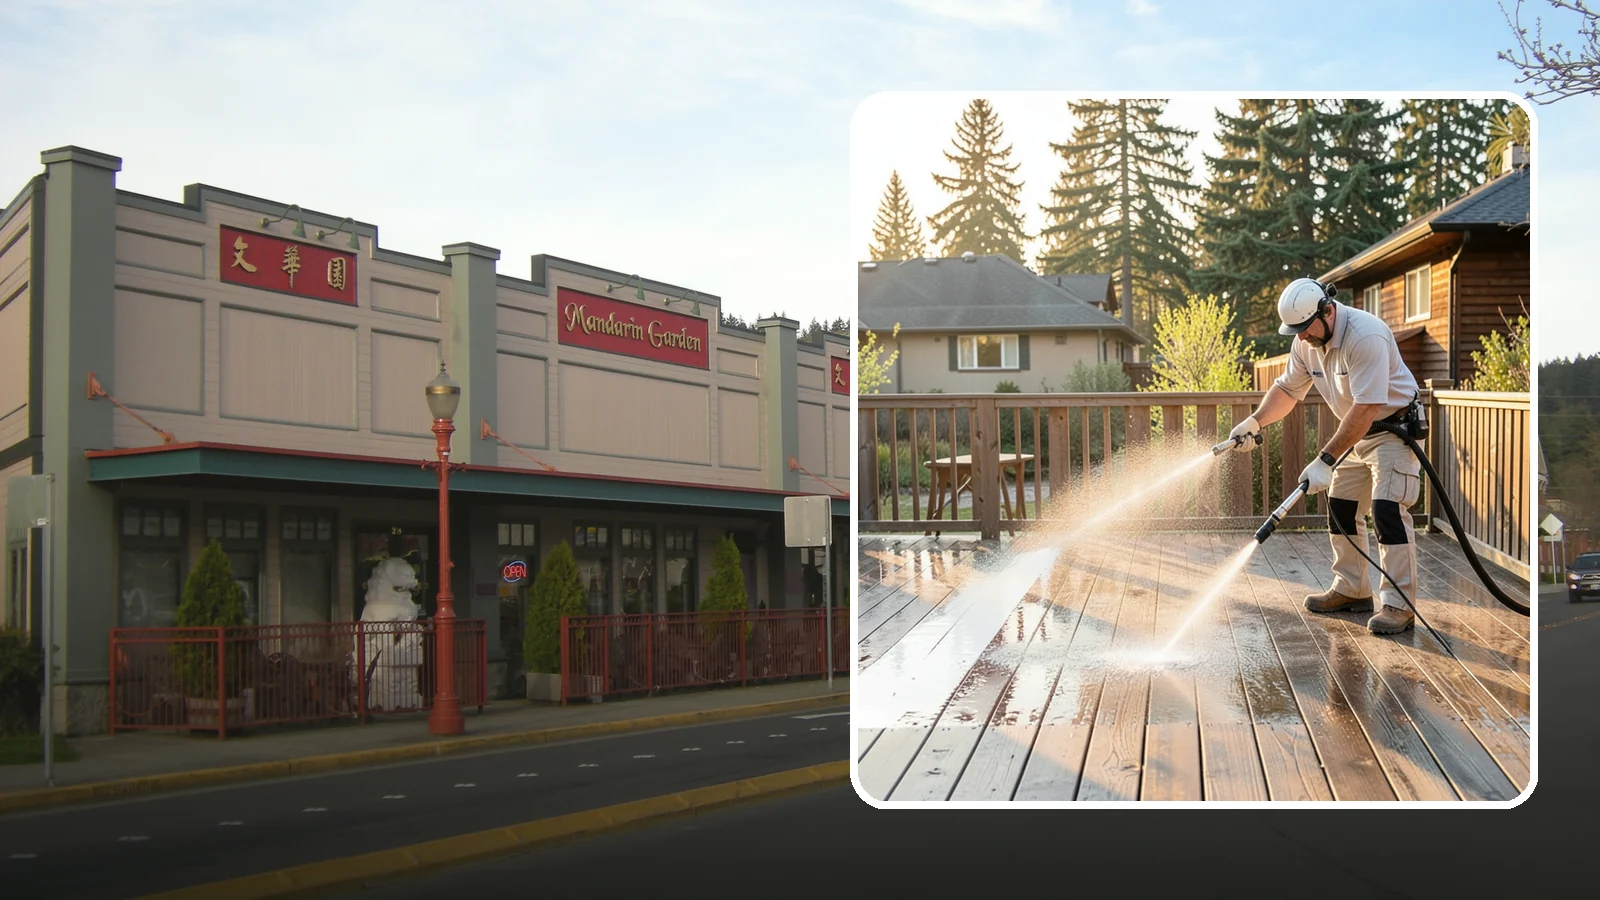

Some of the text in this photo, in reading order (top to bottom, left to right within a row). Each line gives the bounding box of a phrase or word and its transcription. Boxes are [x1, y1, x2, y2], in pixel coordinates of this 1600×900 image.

[230, 235, 346, 291] 文華園
[564, 302, 702, 352] Mandarin Garden
[503, 565, 527, 578] OPEN
